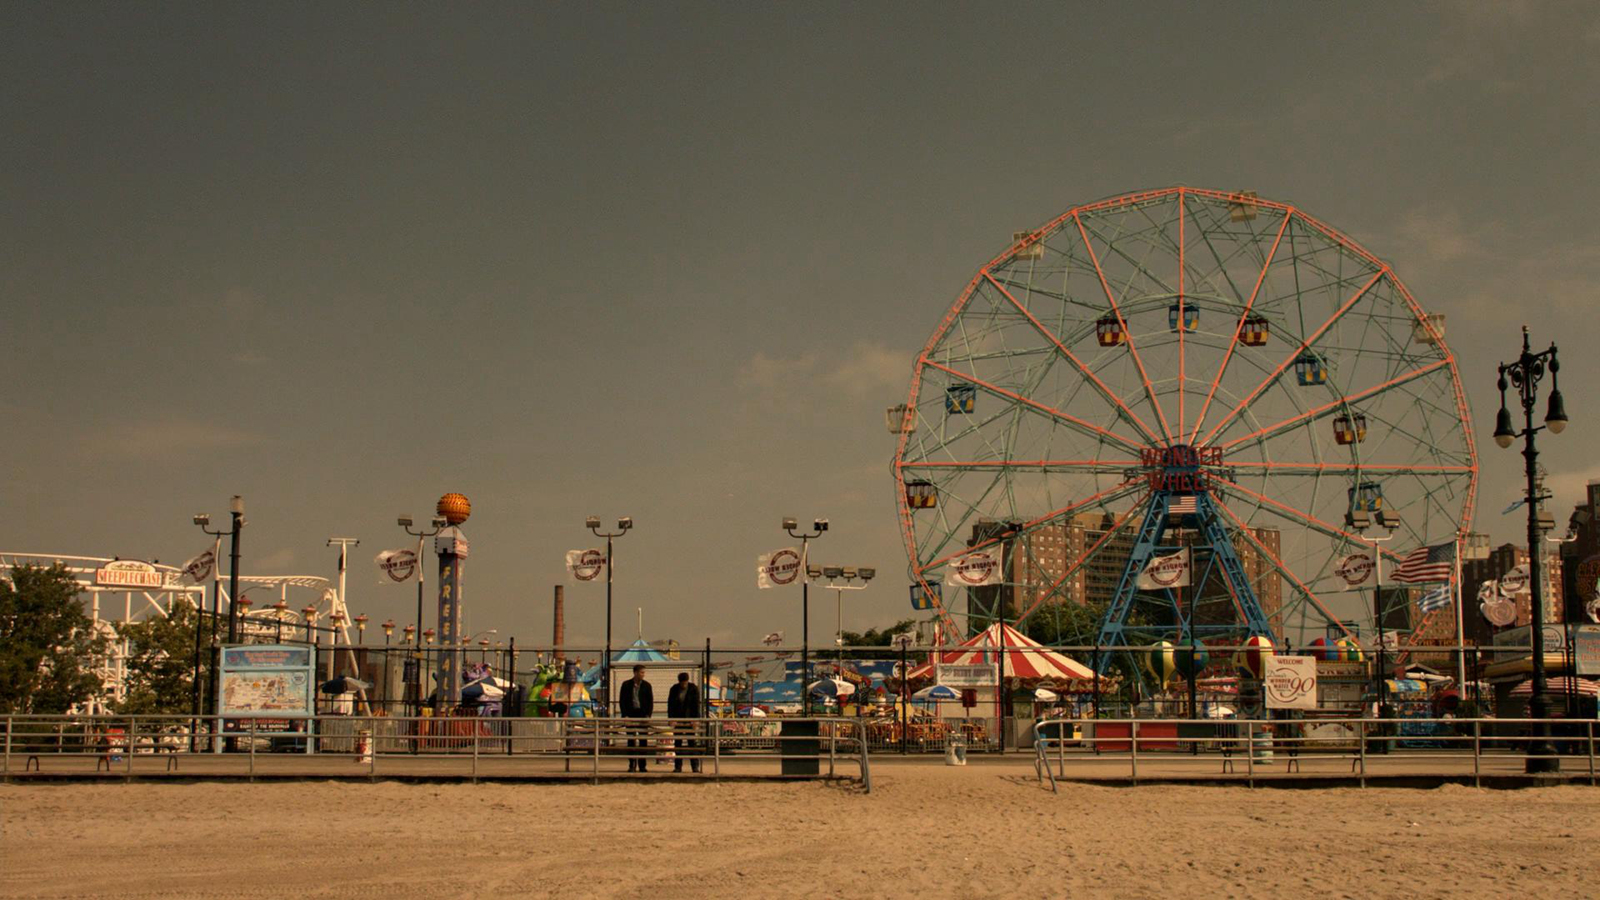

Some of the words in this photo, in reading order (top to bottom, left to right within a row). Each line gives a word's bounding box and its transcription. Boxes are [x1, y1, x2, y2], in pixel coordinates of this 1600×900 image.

[1139, 446, 1224, 466] WONDER
[1147, 469, 1218, 491] WHEEL
[98, 570, 160, 585] STEEPLECHASE
[1290, 677, 1315, 698] 90
